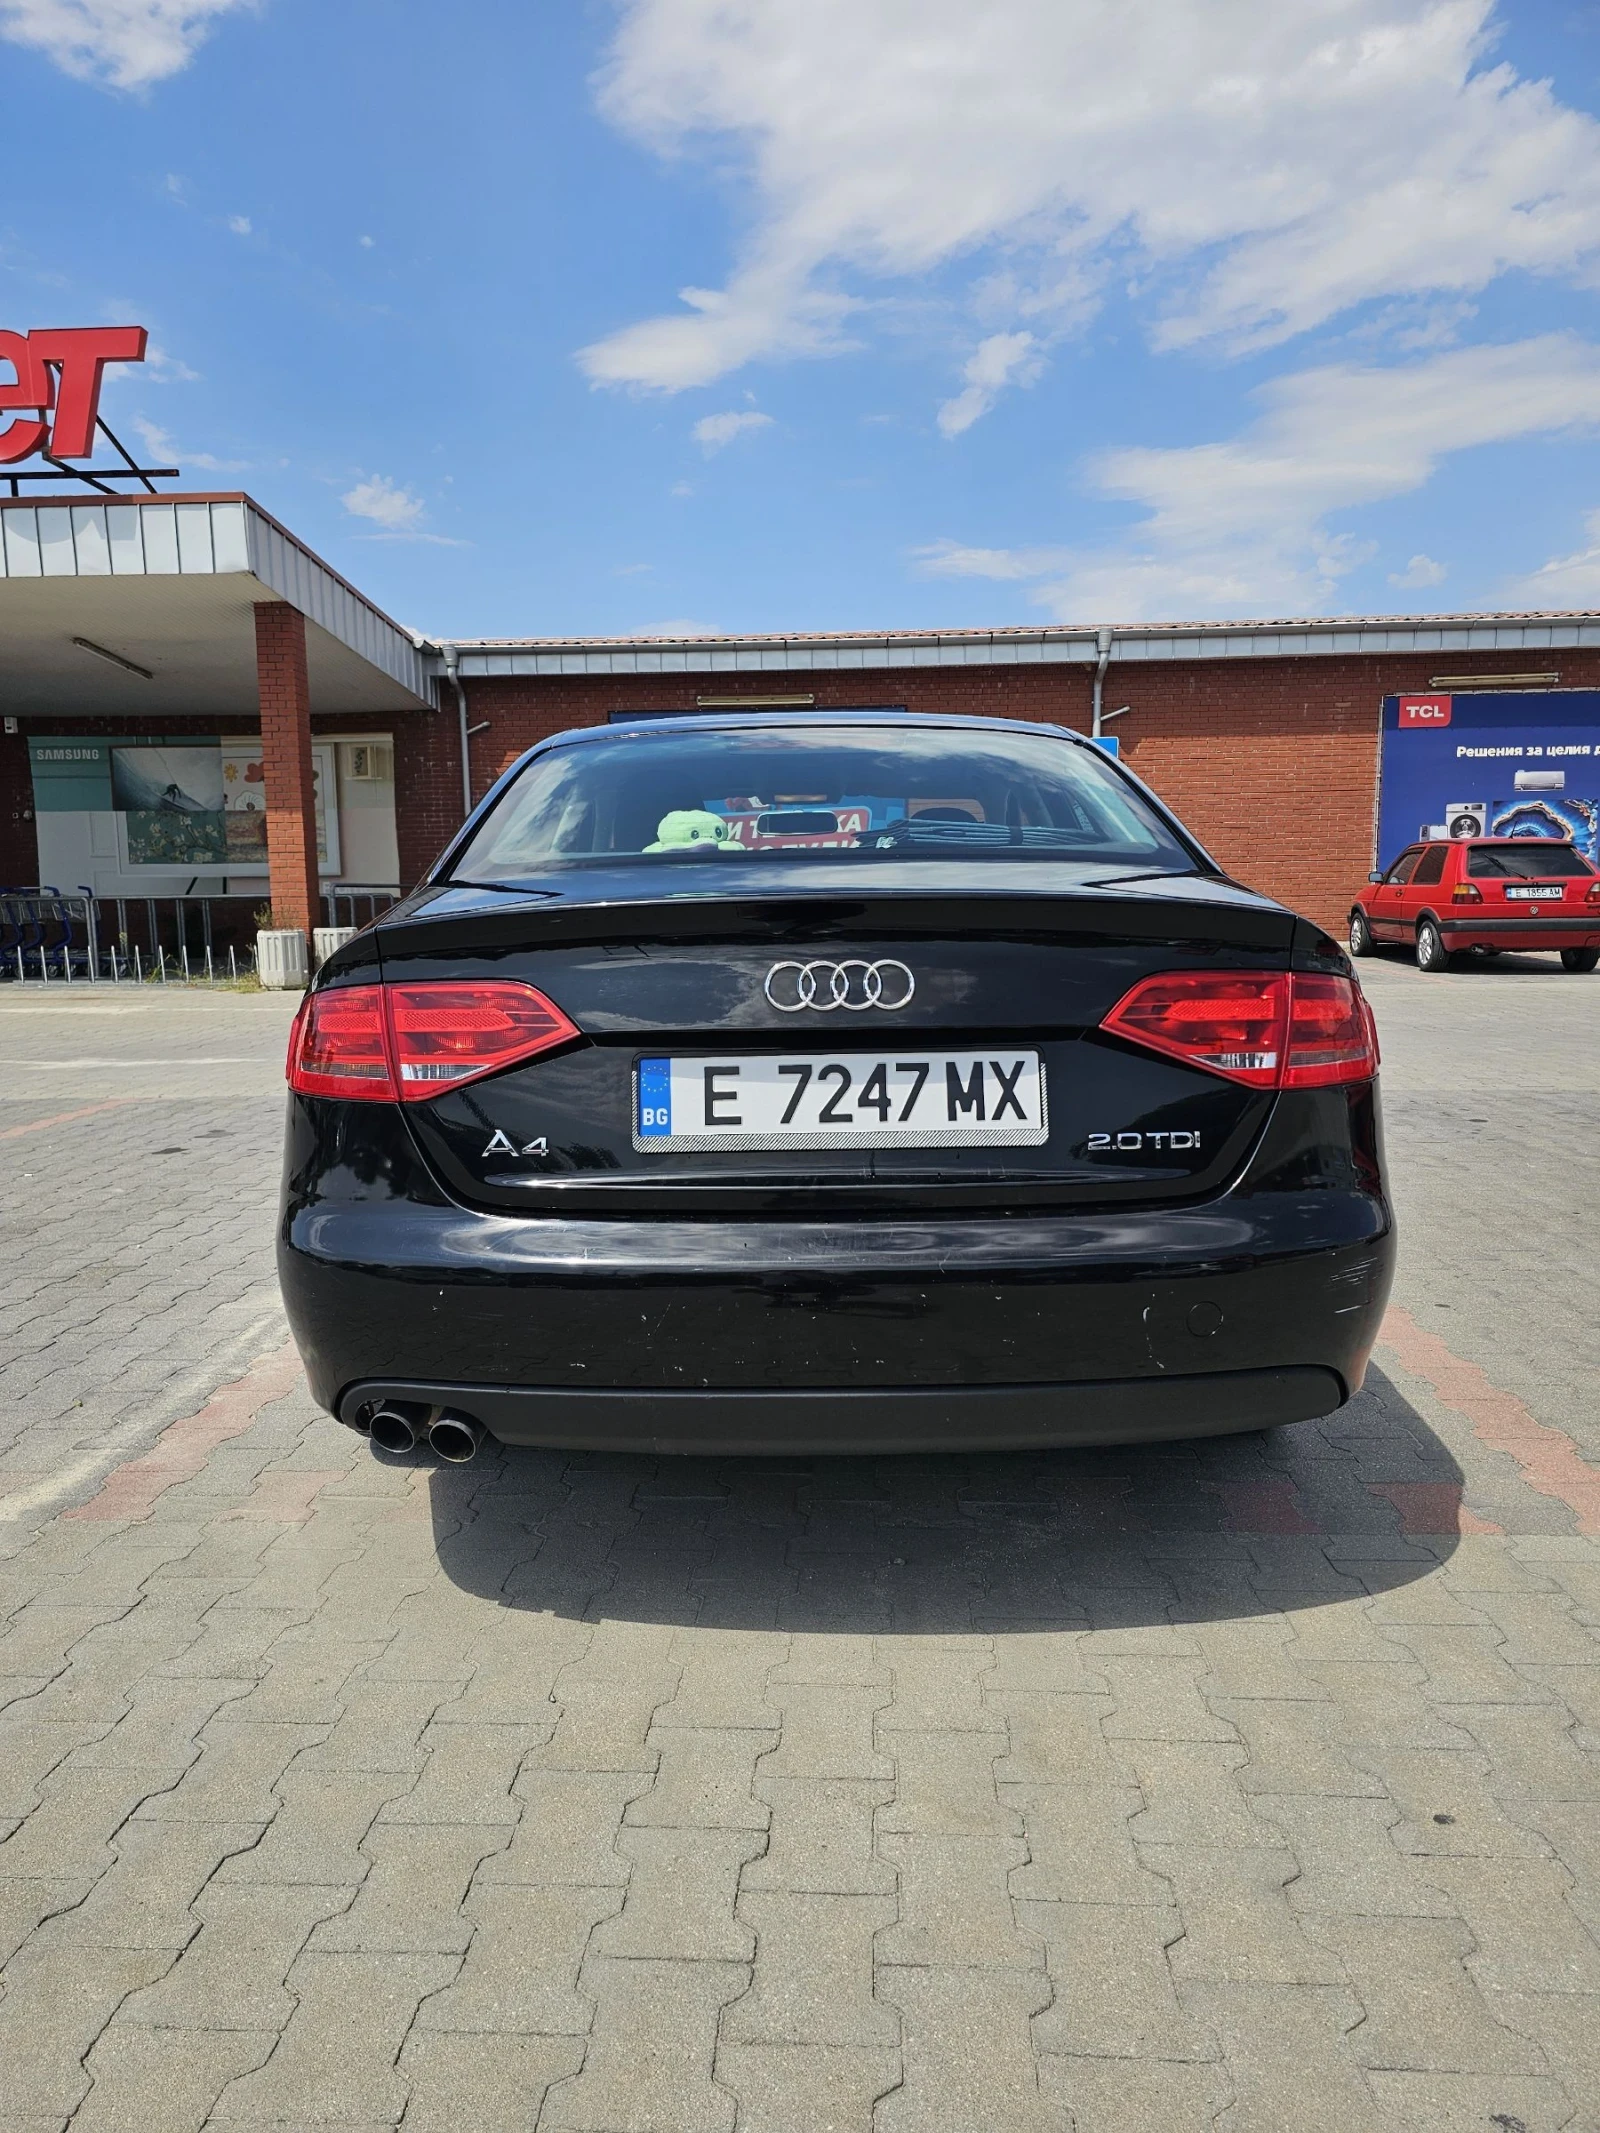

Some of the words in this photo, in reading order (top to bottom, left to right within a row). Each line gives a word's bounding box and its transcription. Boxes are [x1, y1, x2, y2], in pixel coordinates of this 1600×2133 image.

[1406, 705, 1444, 718] TCL
[36, 749, 99, 760] SAMSUNG
[1456, 746, 1523, 758] Решения
[1526, 746, 1543, 756] за
[1546, 745, 1591, 757] целия
[1527, 888, 1547, 897] 1855
[704, 1066, 743, 1126] E
[777, 1062, 930, 1124] 7247
[945, 1061, 1028, 1122] MX
[643, 1107, 668, 1126] BG
[481, 1129, 550, 1157] A4
[1087, 1132, 1142, 1151] 2.0
